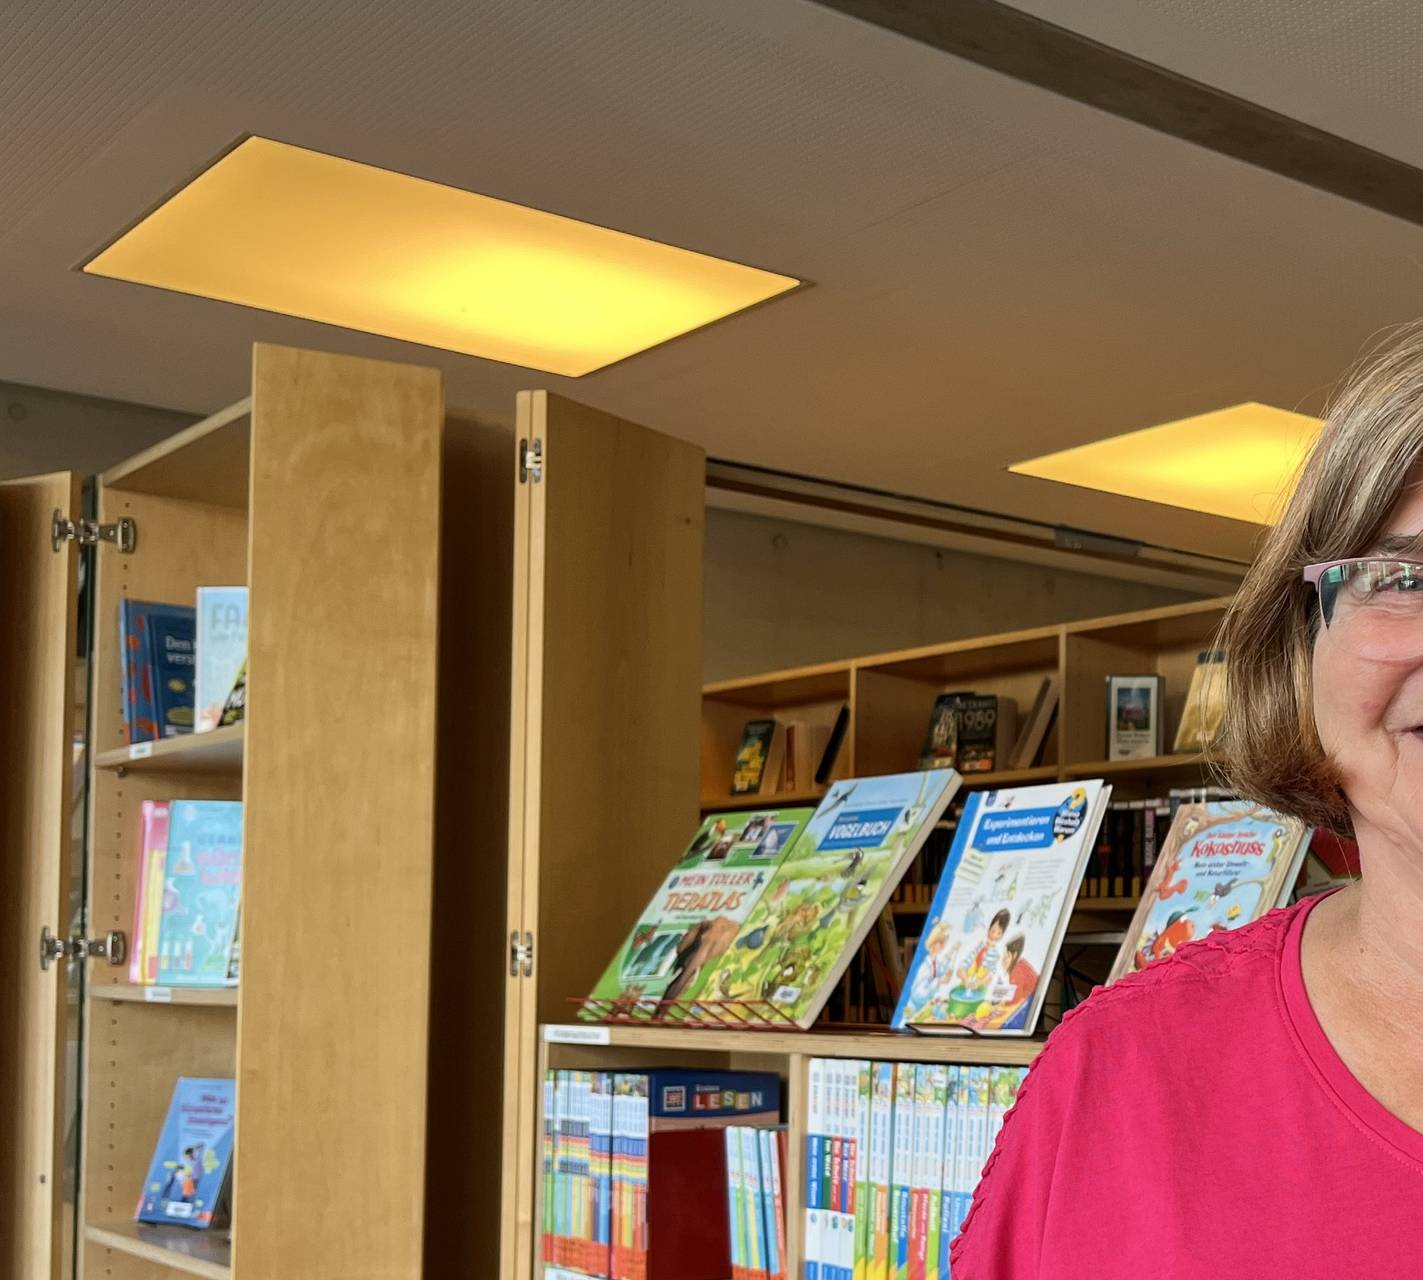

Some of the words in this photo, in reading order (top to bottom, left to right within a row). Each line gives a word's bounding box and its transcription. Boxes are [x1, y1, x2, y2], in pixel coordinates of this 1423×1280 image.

[956, 709, 996, 731] 1989
[828, 820, 894, 840] VOGELBUCH
[983, 815, 1050, 832] Experimentieren
[1001, 831, 1046, 845] Entdecken
[1191, 841, 1266, 857] Kokosnuss
[708, 871, 754, 886] TOLLER
[694, 1090, 763, 1110] LESEN
